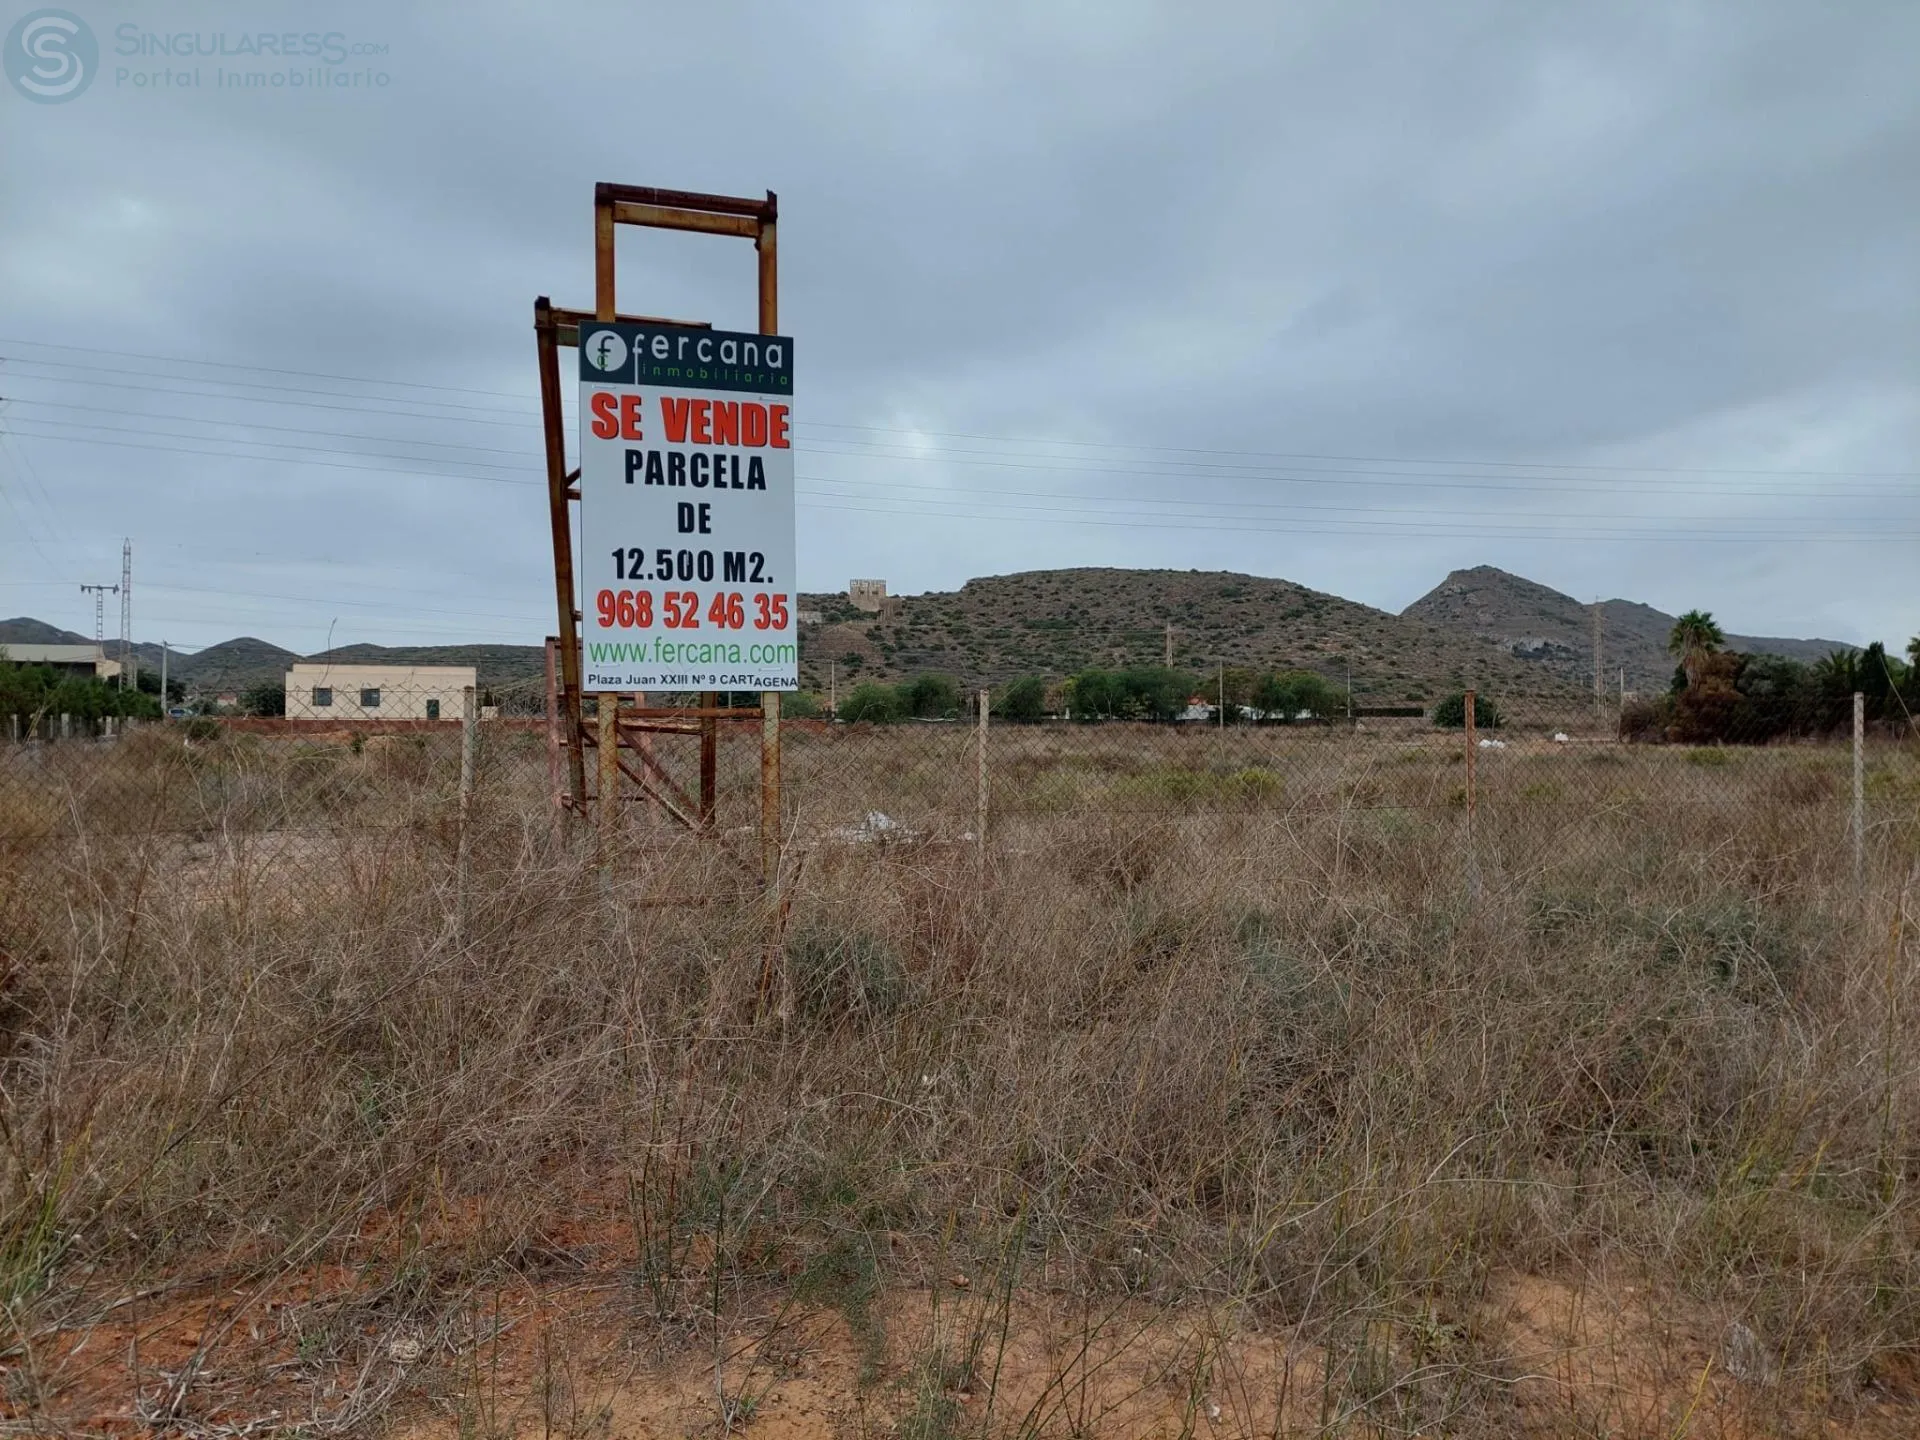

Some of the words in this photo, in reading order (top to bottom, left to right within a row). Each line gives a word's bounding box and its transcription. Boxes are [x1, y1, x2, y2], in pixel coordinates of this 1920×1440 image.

[632, 334, 784, 386] fercana
[642, 363, 788, 386] inmobiliaria
[591, 391, 643, 440] SE
[660, 396, 791, 449] VENDE
[625, 449, 767, 490] PARCELA
[677, 502, 712, 534] DE
[611, 547, 714, 582] 12.500
[723, 551, 774, 584] M2.
[596, 588, 654, 629] 968
[663, 591, 700, 629] 52
[708, 591, 745, 630] 46
[753, 592, 789, 631] 35
[589, 636, 796, 664] www.fercana.com
[588, 674, 622, 685] Plaza
[626, 674, 656, 685] Juan
[660, 674, 688, 685] XXIII
[708, 674, 717, 685] 9
[719, 674, 799, 688] CARTAGENA
